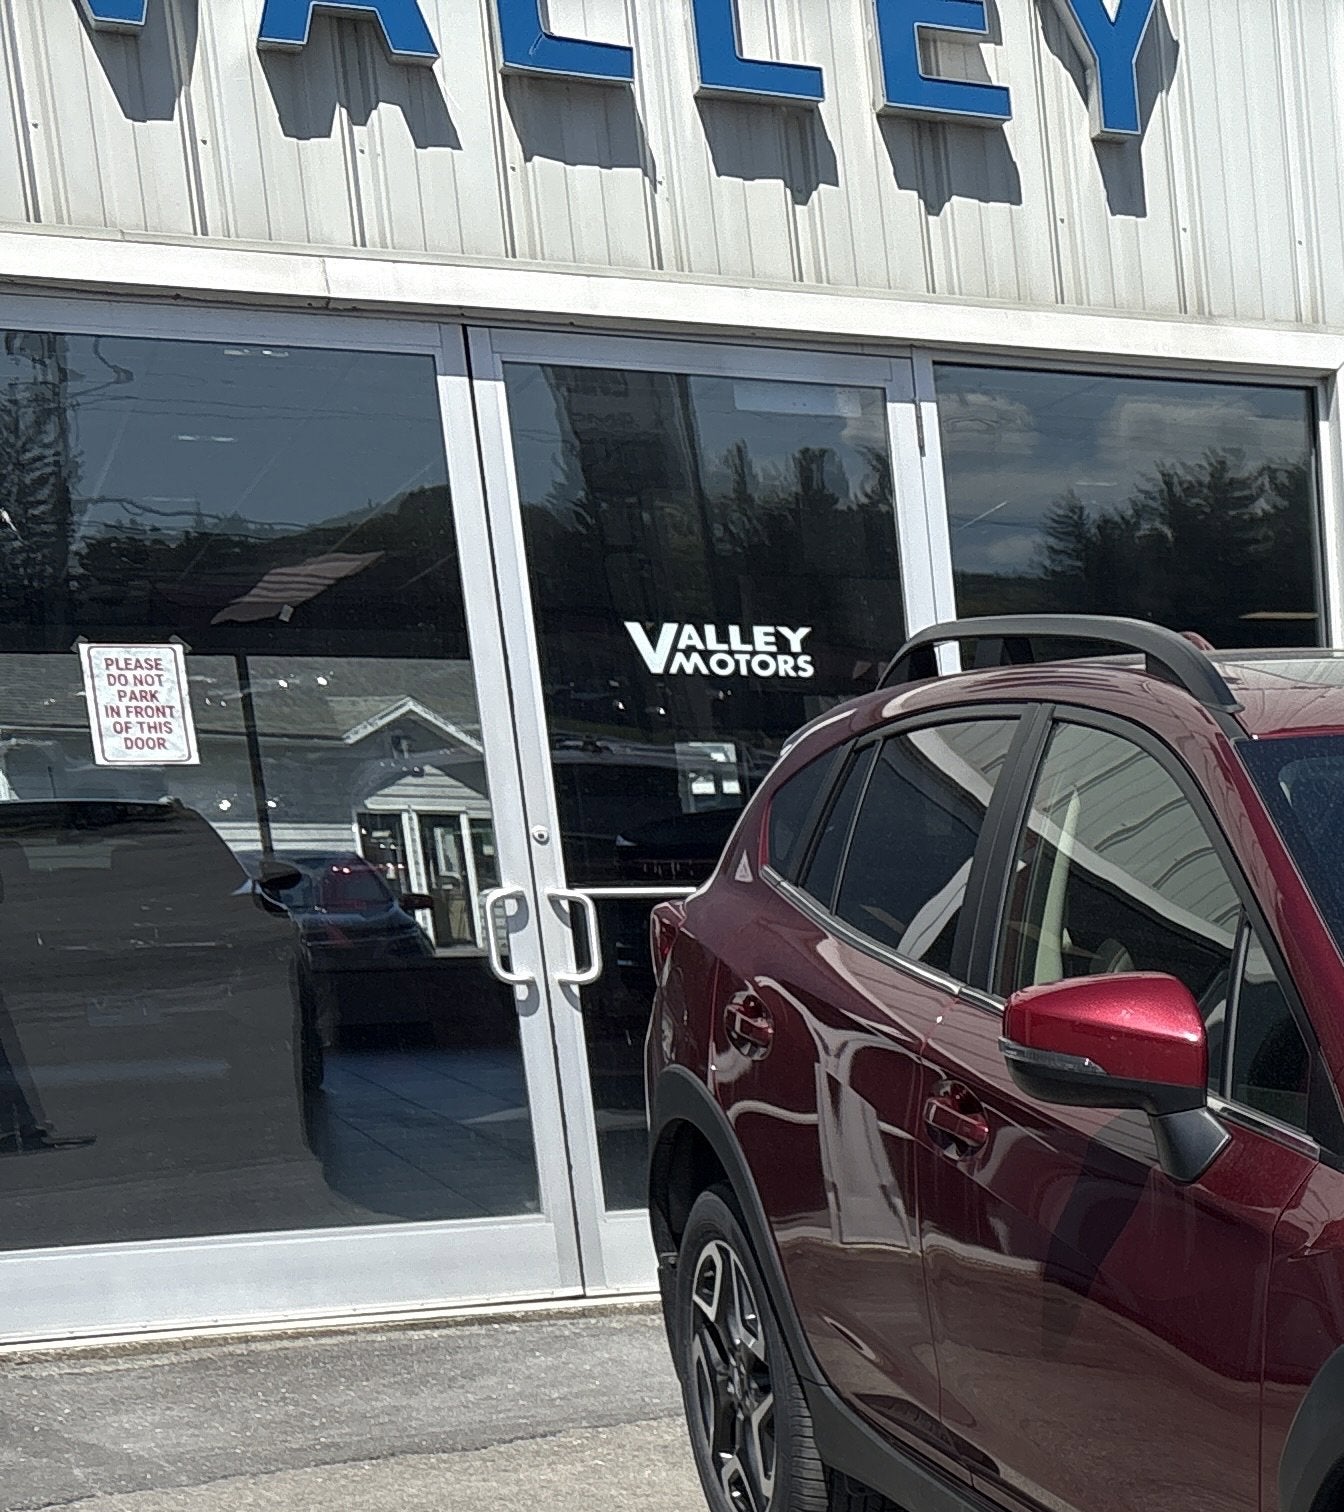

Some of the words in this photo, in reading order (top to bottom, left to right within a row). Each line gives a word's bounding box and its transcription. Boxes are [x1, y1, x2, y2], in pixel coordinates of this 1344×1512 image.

[624, 621, 812, 675] VALLEY
[104, 657, 164, 671] PLEASE
[669, 652, 814, 678] MOTORS
[106, 674, 128, 686] DO
[132, 674, 164, 686] NOT
[117, 690, 160, 702] PARK
[104, 705, 121, 718] IN
[125, 705, 175, 718] FRONT
[113, 721, 133, 734] OF
[136, 721, 173, 734] THIS
[124, 737, 167, 750] DOOR
